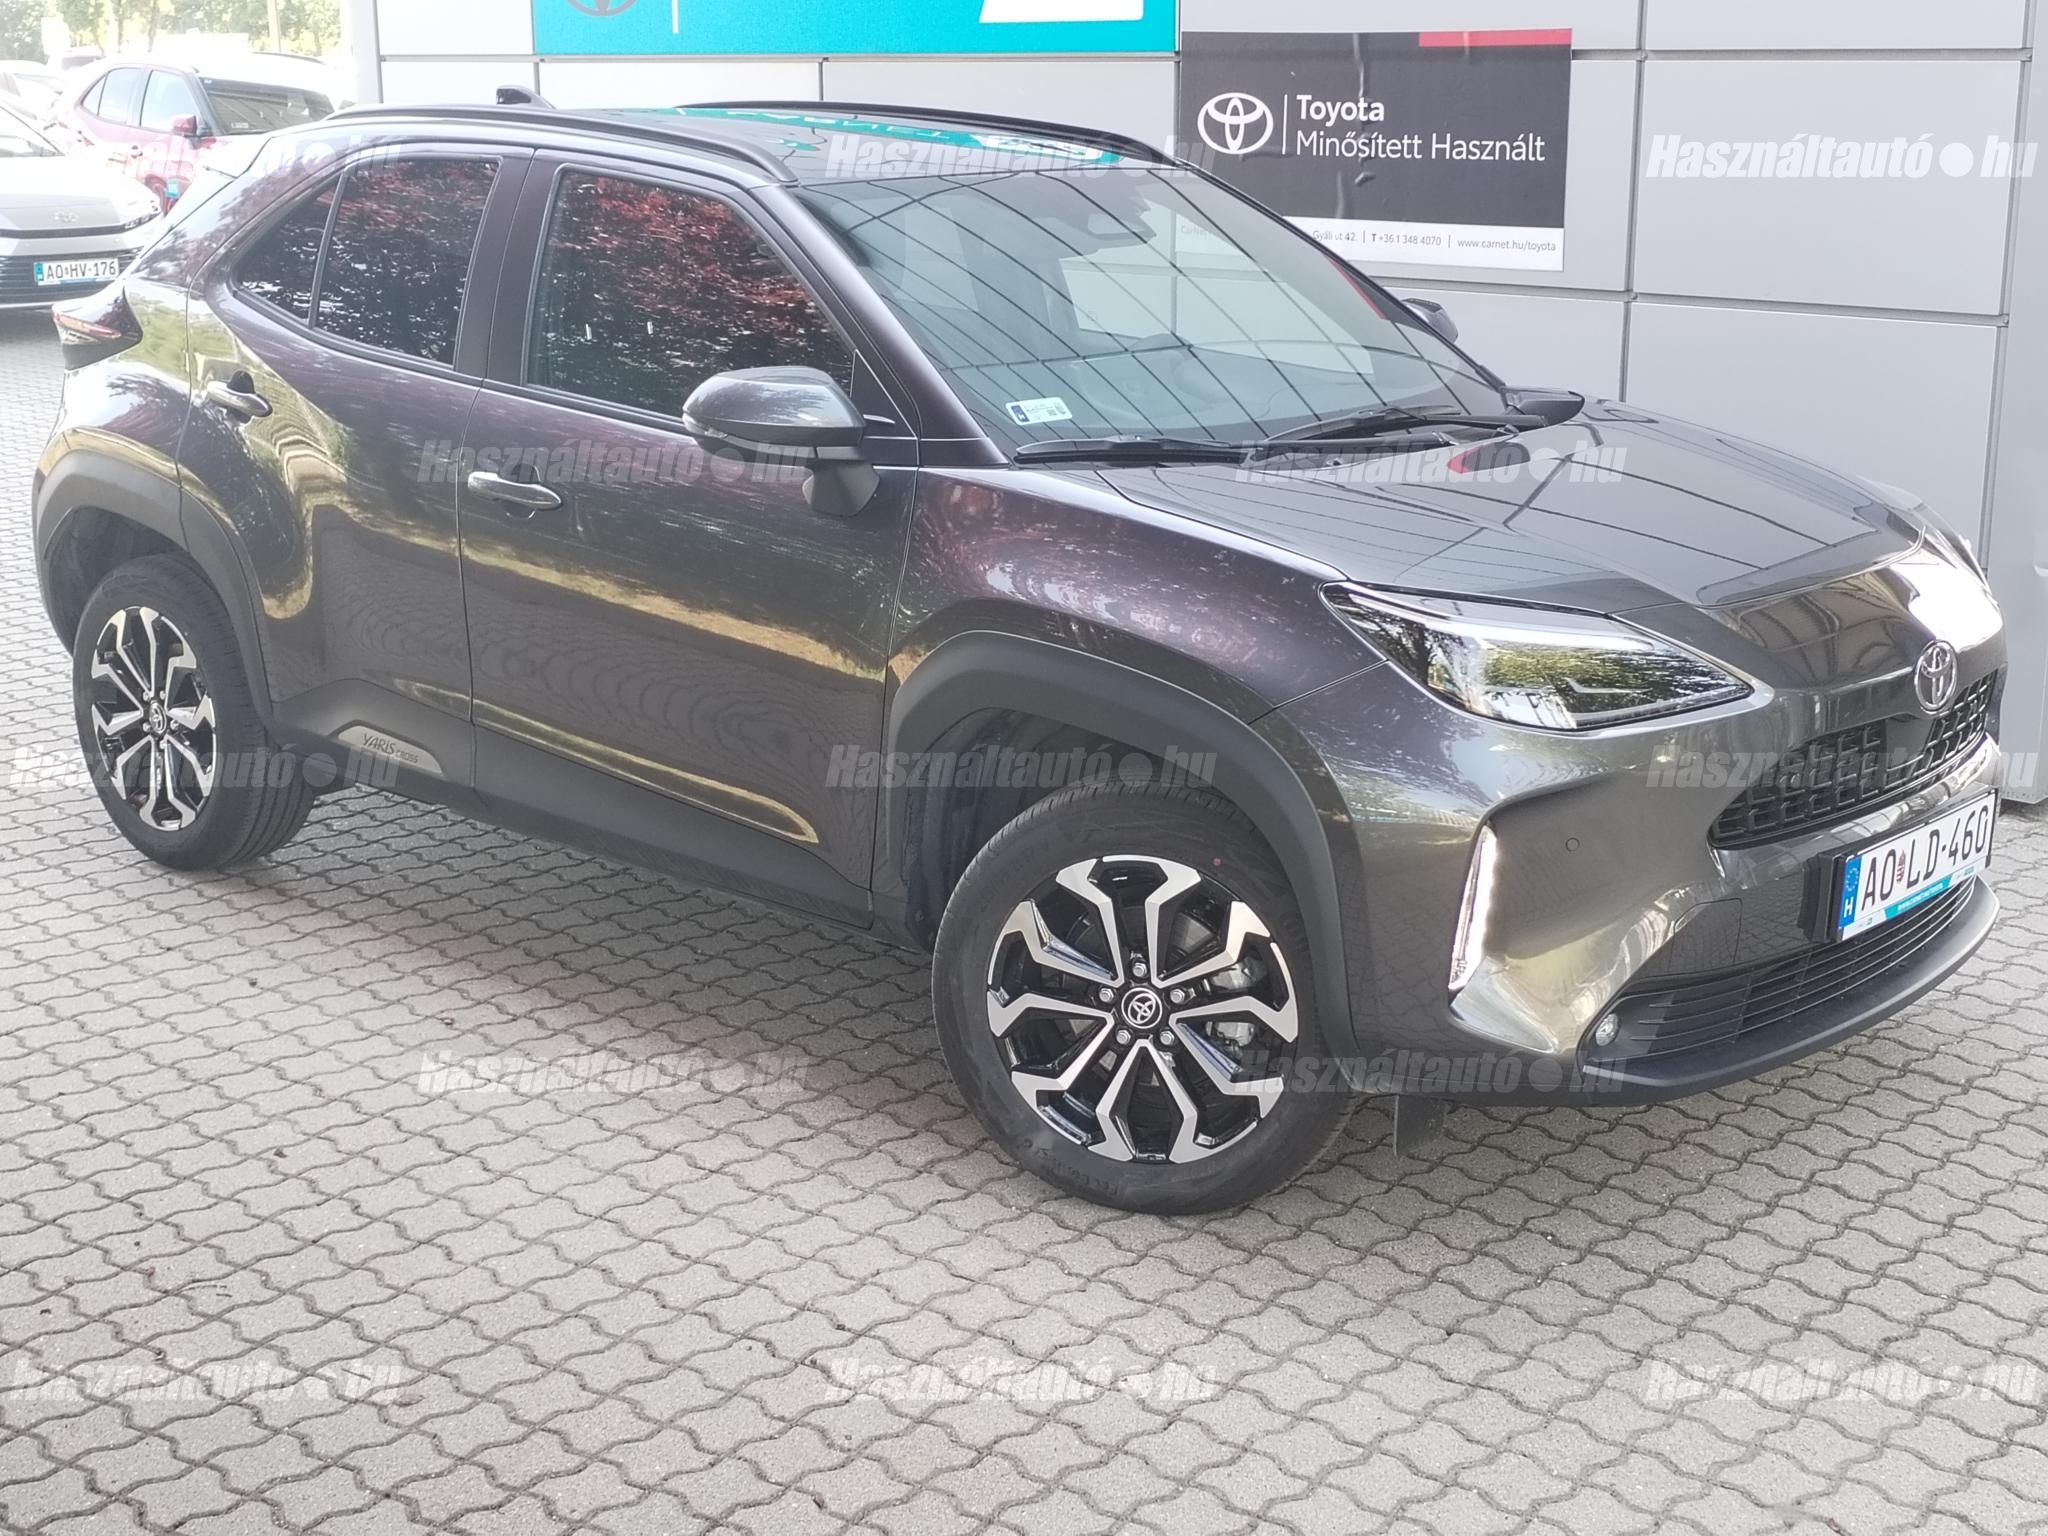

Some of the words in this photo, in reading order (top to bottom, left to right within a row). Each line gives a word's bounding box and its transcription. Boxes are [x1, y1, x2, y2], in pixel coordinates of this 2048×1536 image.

[1297, 94, 1385, 126] Toyota
[1297, 130, 1422, 159] Minősített
[1431, 133, 1546, 161] Használt
[1402, 235, 1418, 245] 348
[1420, 235, 1441, 246] 4070
[1457, 239, 1556, 252] www.carnet.hu/toyota
[69, 261, 116, 277] HV-176
[363, 733, 396, 755] YARIS
[1906, 804, 1989, 889] LD-460
[1843, 896, 1855, 918] H
